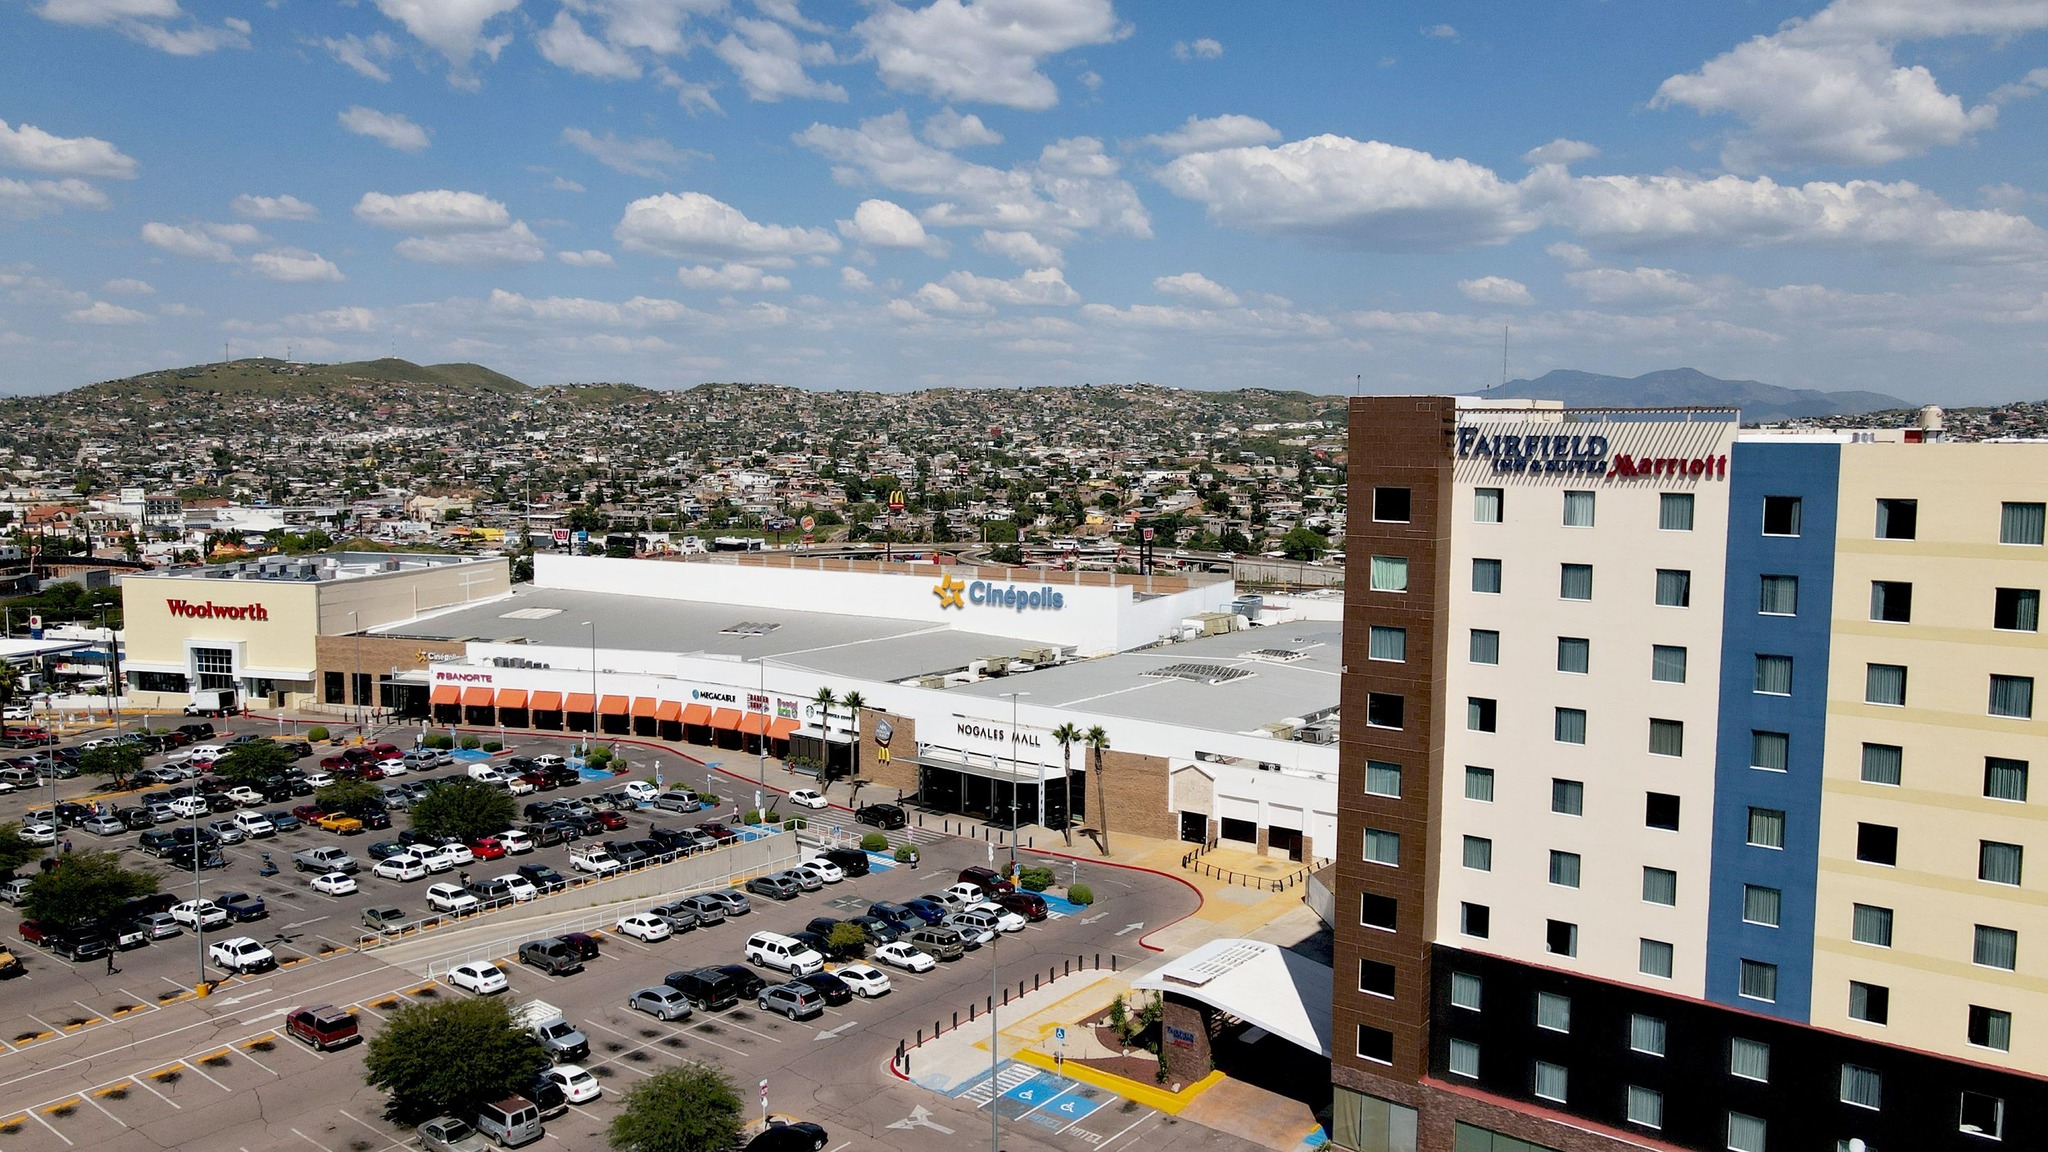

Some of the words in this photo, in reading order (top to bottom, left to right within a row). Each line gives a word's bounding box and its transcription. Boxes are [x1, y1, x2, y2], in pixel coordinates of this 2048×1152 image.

[1458, 427, 1608, 458] FAIRFIELD
[1606, 453, 1727, 478] Marriott
[969, 581, 1064, 612] Cinépolis
[166, 598, 268, 621] Woolworth
[446, 672, 493, 682] BANORTE
[957, 723, 1004, 741] NOGALES
[1011, 732, 1041, 747] MALL
[1067, 1125, 1104, 1145] HOTEL
